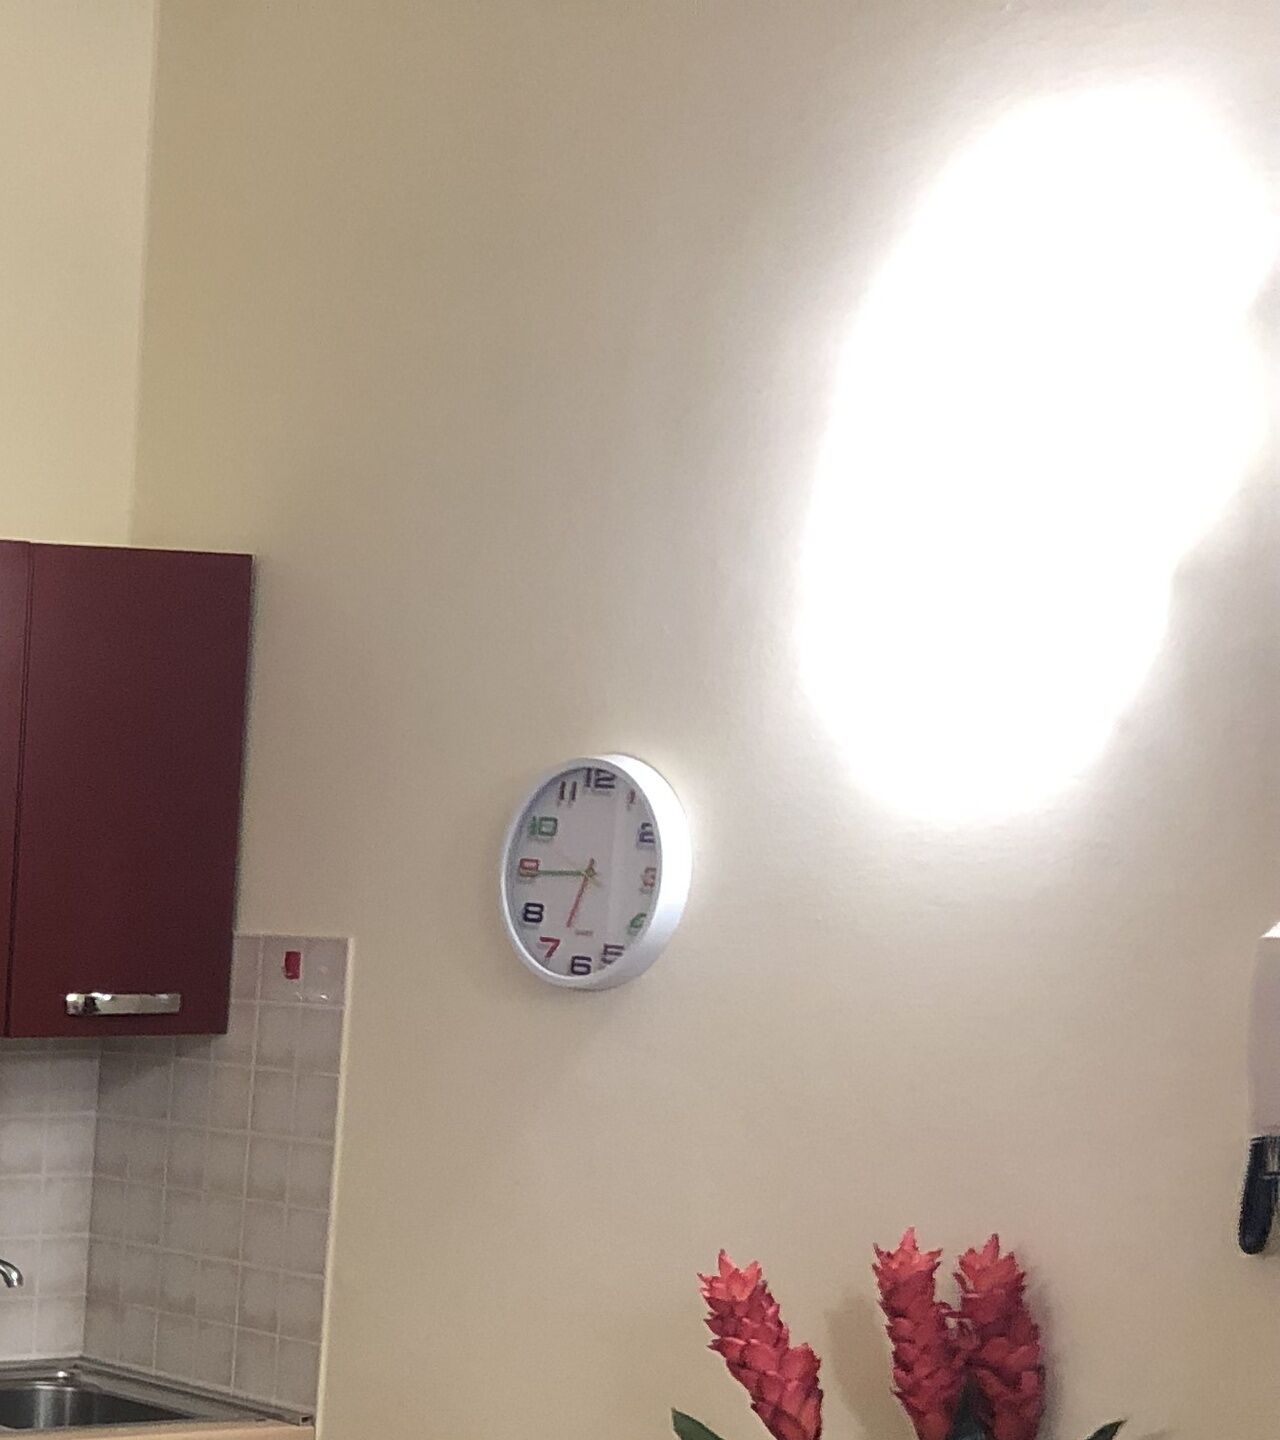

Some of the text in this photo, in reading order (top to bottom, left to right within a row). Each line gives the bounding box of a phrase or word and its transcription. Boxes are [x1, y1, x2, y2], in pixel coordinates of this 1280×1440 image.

[584, 767, 615, 789] 12
[560, 781, 576, 801] 11
[523, 903, 544, 923] 8
[540, 936, 560, 959] 7
[571, 956, 592, 976] 6
